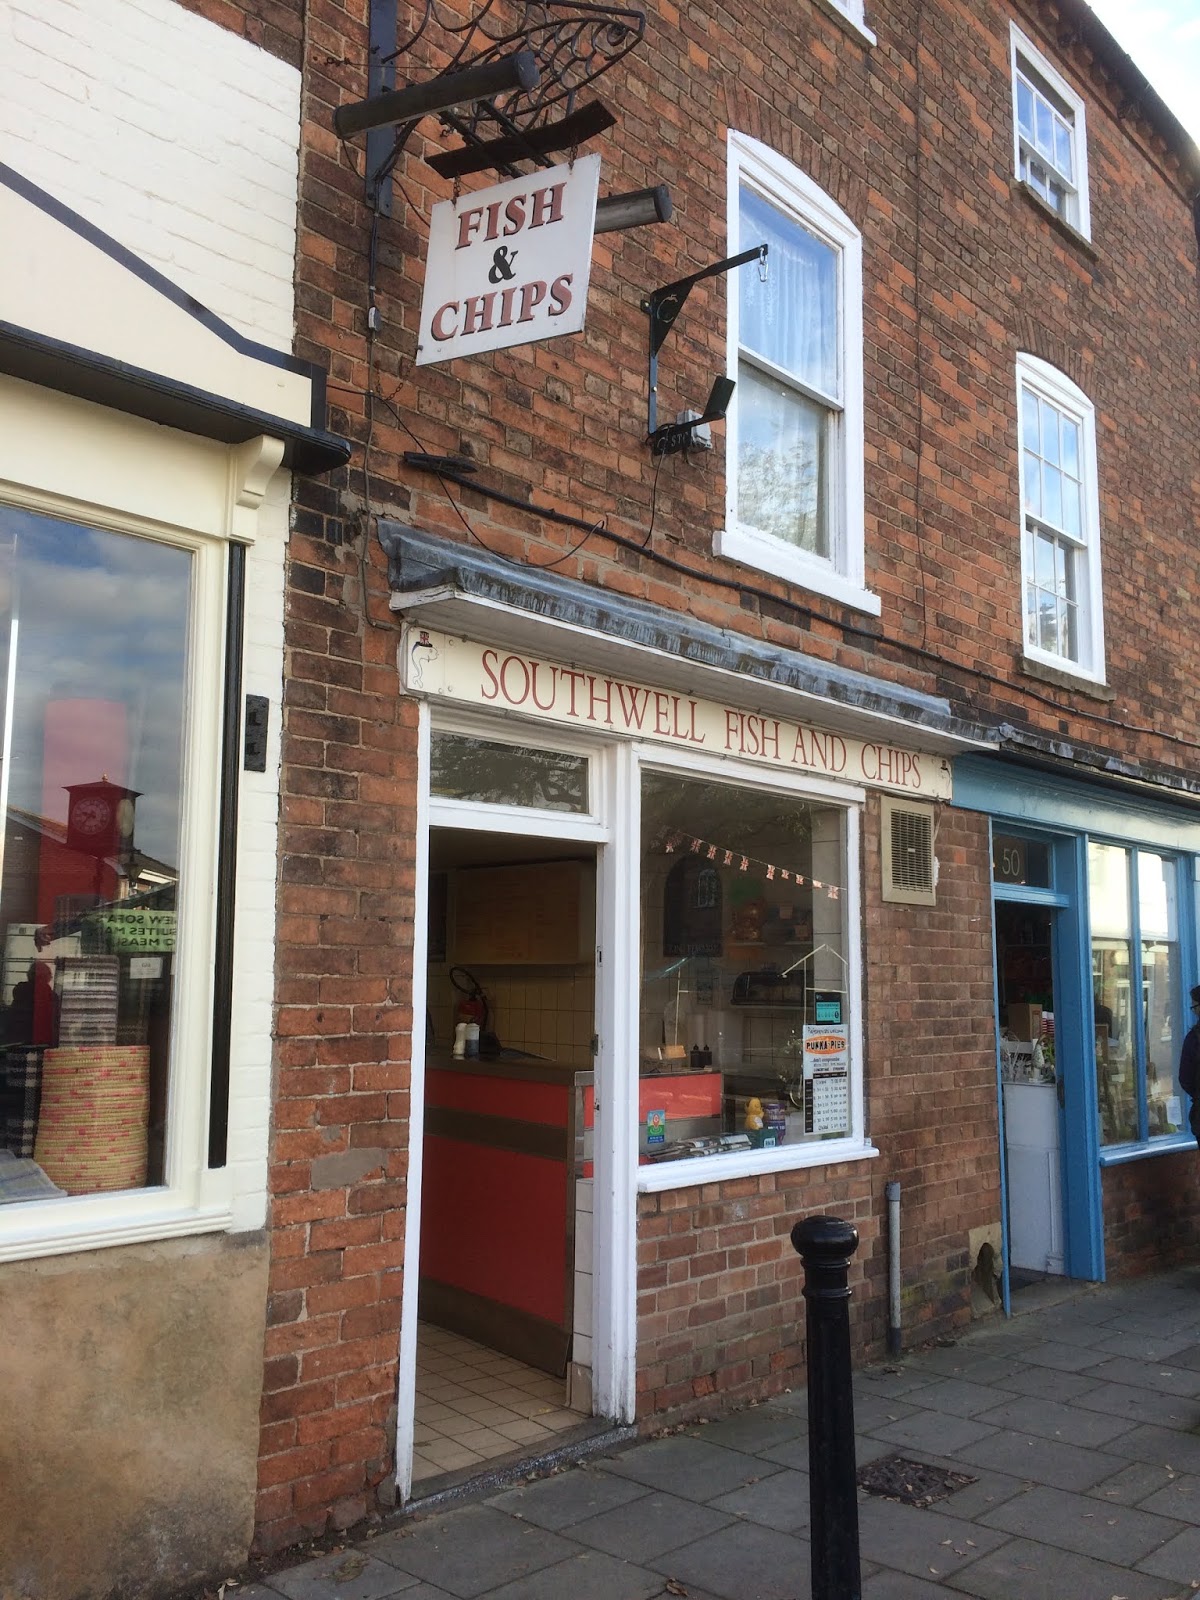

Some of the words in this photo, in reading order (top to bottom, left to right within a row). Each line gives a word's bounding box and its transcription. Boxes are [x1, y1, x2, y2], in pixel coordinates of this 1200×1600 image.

[455, 182, 567, 250] FISH
[488, 245, 518, 284] &
[431, 273, 573, 341] CHIPS
[480, 649, 706, 744] SOUTHWELL
[724, 709, 781, 760] FISH
[791, 727, 847, 773] AND
[860, 742, 922, 789] CHIPS
[1002, 848, 1020, 876] 50
[831, 1040, 845, 1049] PIES
